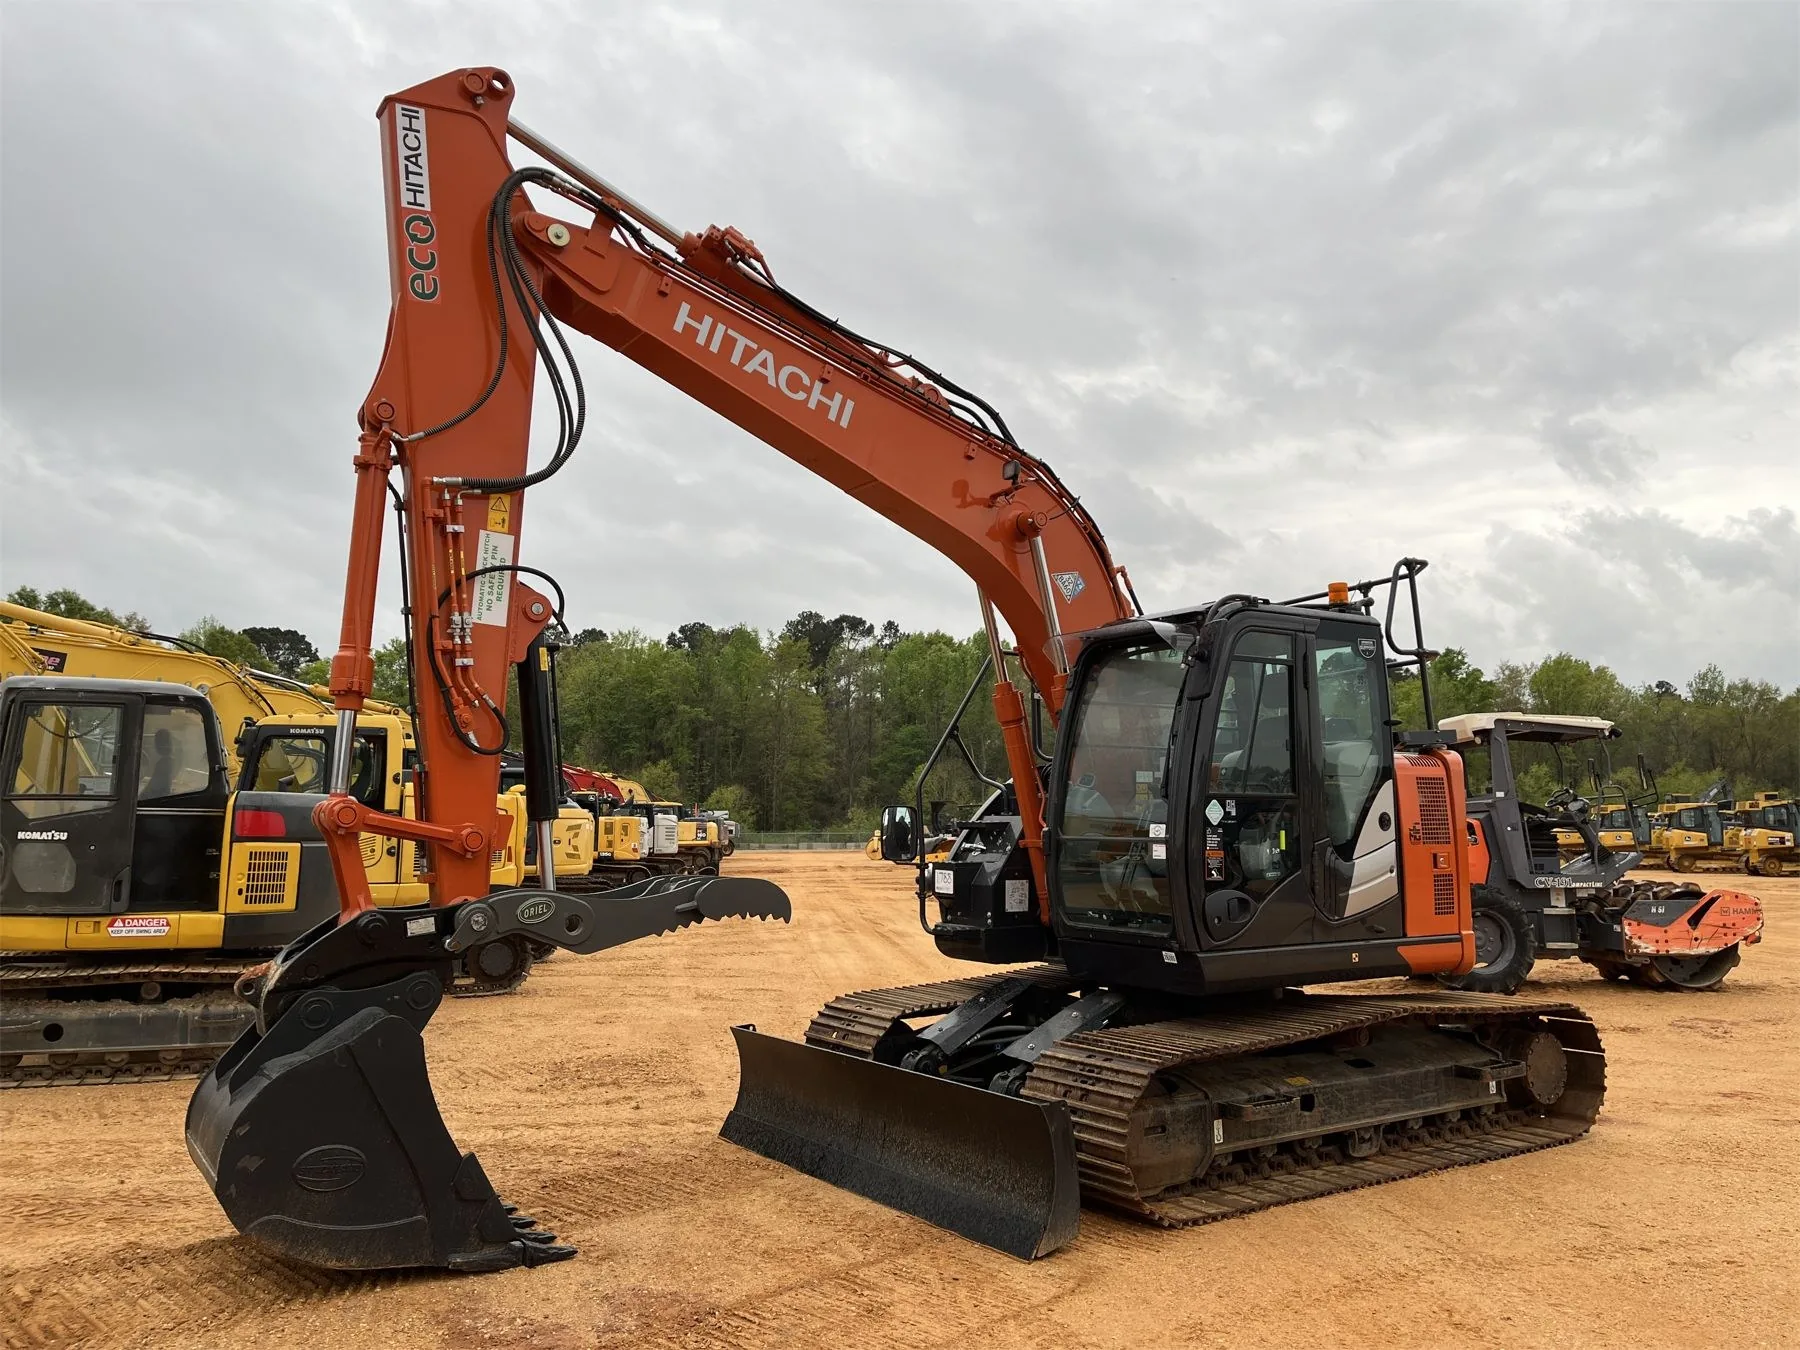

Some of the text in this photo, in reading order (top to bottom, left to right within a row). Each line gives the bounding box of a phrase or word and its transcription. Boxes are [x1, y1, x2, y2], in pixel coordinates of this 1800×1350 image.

[401, 106, 426, 208] HITACHI
[673, 301, 855, 429] HITACHI
[486, 598, 493, 612] NO
[490, 545, 498, 561] PIN
[477, 581, 486, 620] AUTOMATIC
[289, 727, 325, 735] KOMATSU
[17, 830, 68, 841] KOMATSU
[125, 918, 167, 927] DANGER
[524, 903, 548, 919] ORIEL
